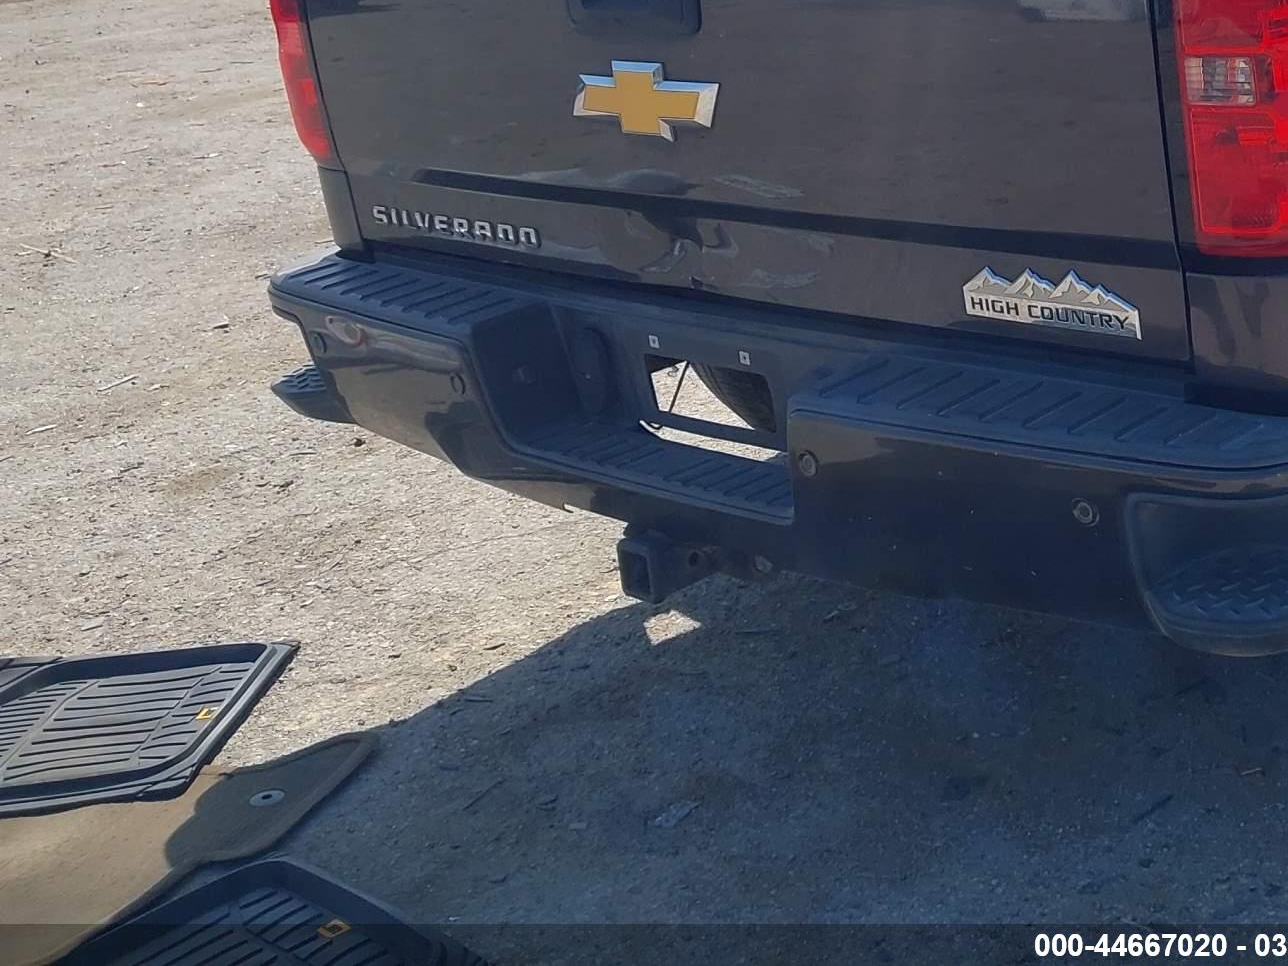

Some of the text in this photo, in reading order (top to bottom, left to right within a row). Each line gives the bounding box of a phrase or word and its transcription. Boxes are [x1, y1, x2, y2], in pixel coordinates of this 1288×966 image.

[372, 205, 540, 247] SILVERADO
[970, 296, 1129, 330] HIGH COUNTRY
